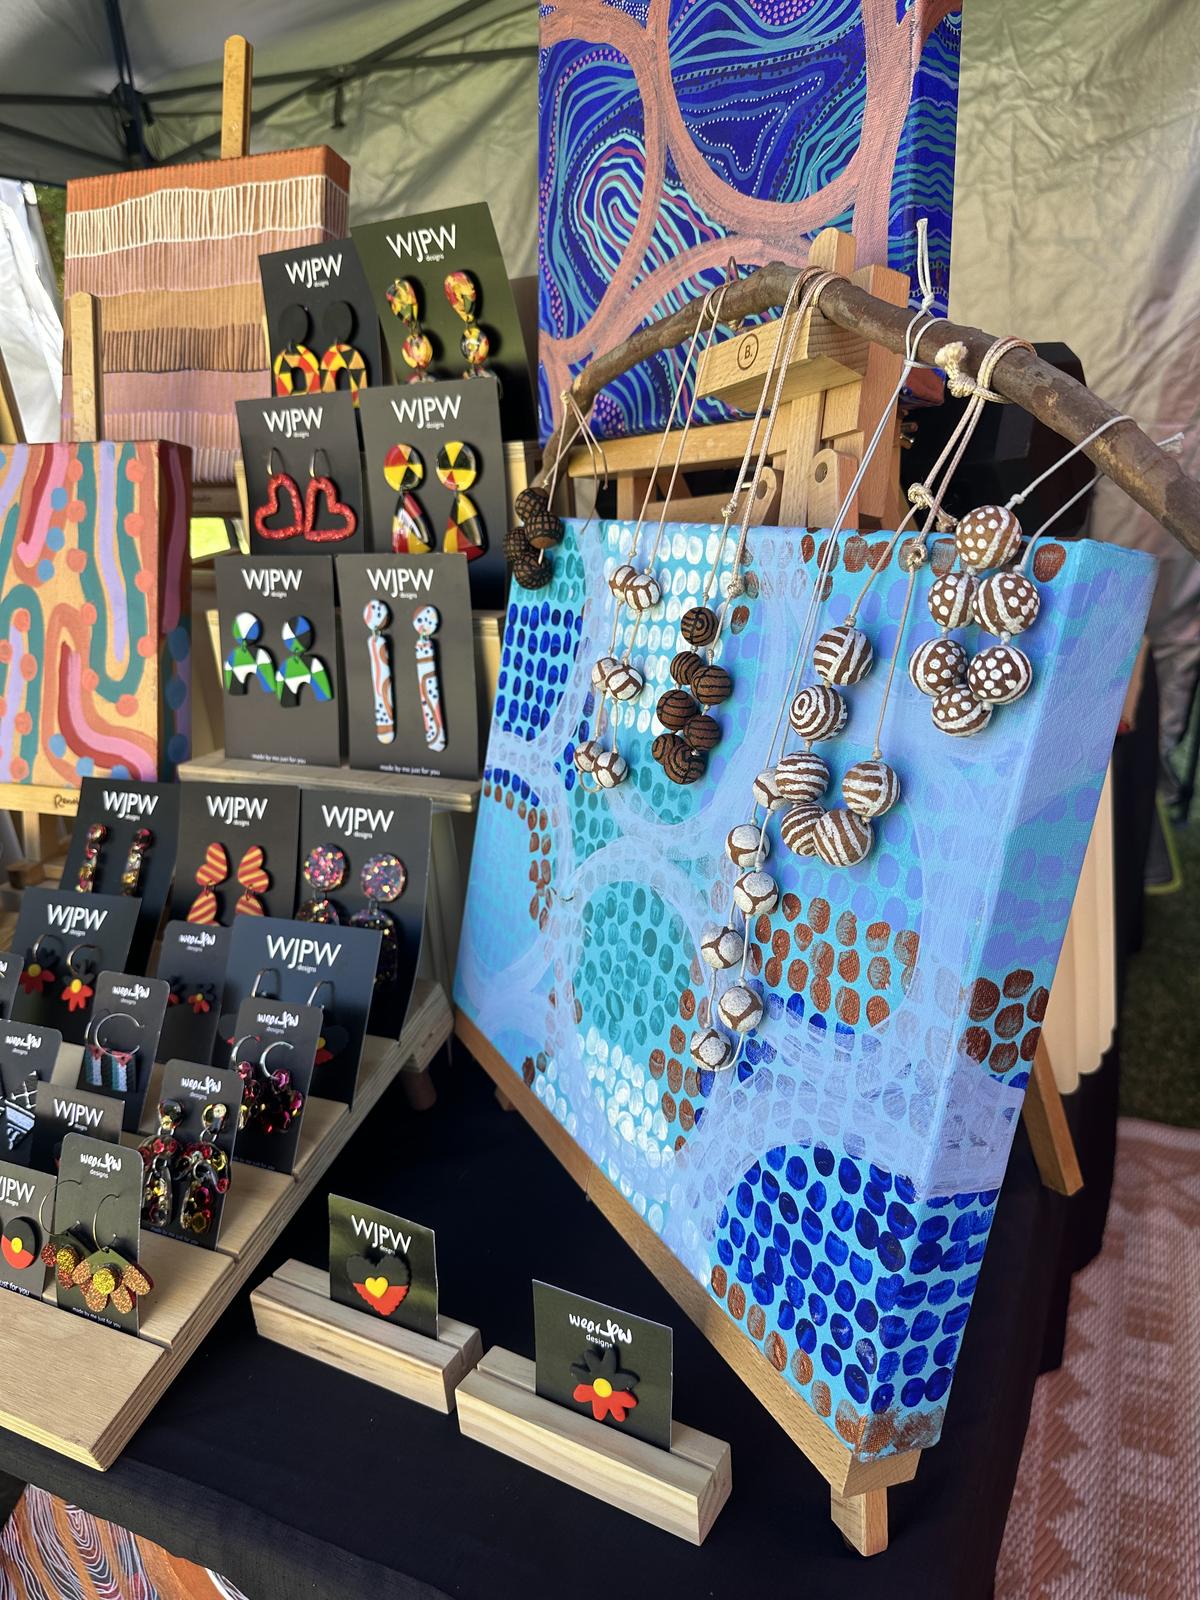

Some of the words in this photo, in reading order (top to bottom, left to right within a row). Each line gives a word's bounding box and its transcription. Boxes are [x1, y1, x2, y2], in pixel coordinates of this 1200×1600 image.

[386, 224, 456, 262] WJPW
[284, 252, 343, 288] WJPW
[263, 407, 324, 437] WJPW
[391, 396, 462, 429] WJPW
[242, 569, 303, 596] WJPW
[367, 569, 434, 597] WJPW
[103, 790, 159, 818] WJPW
[206, 795, 268, 824] WJPW
[322, 805, 395, 837] WJPW
[47, 903, 108, 934] WJPW
[266, 934, 342, 970] WJPW
[54, 1098, 104, 1127] WJPW
[89, 1168, 109, 1179] designs
[0, 1175, 36, 1203] JPW
[351, 1214, 412, 1254] WJPW
[9, 1282, 18, 1291] for
[19, 1287, 30, 1296] you
